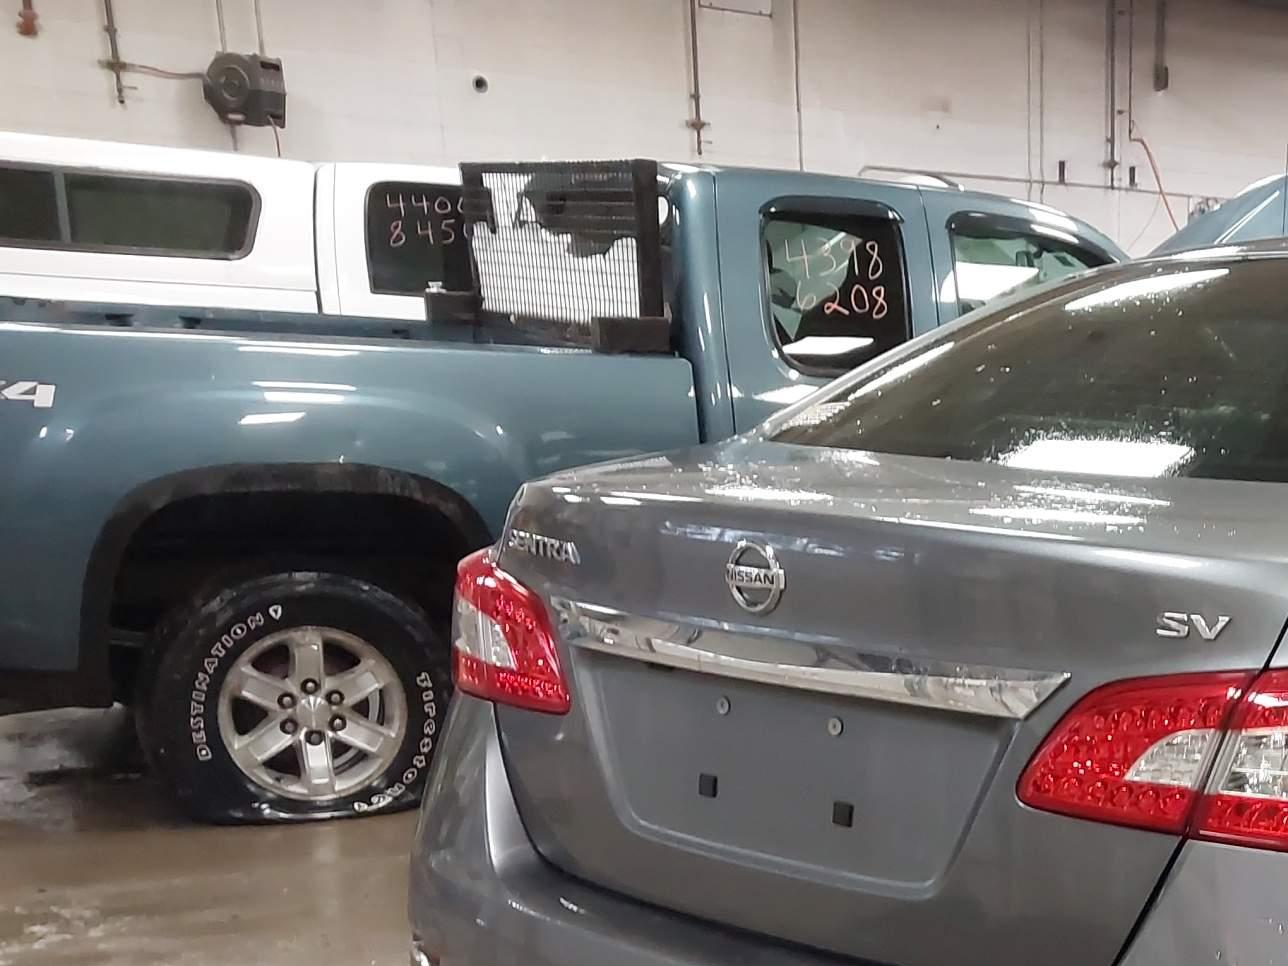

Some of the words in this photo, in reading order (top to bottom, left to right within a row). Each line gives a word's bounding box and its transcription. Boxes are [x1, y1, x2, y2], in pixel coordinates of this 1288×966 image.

[796, 274, 888, 319] 6208
[509, 528, 581, 566] SENTRA
[728, 566, 776, 586] NISSAN
[1156, 611, 1231, 641] SV
[190, 611, 265, 762] DESTINATION
